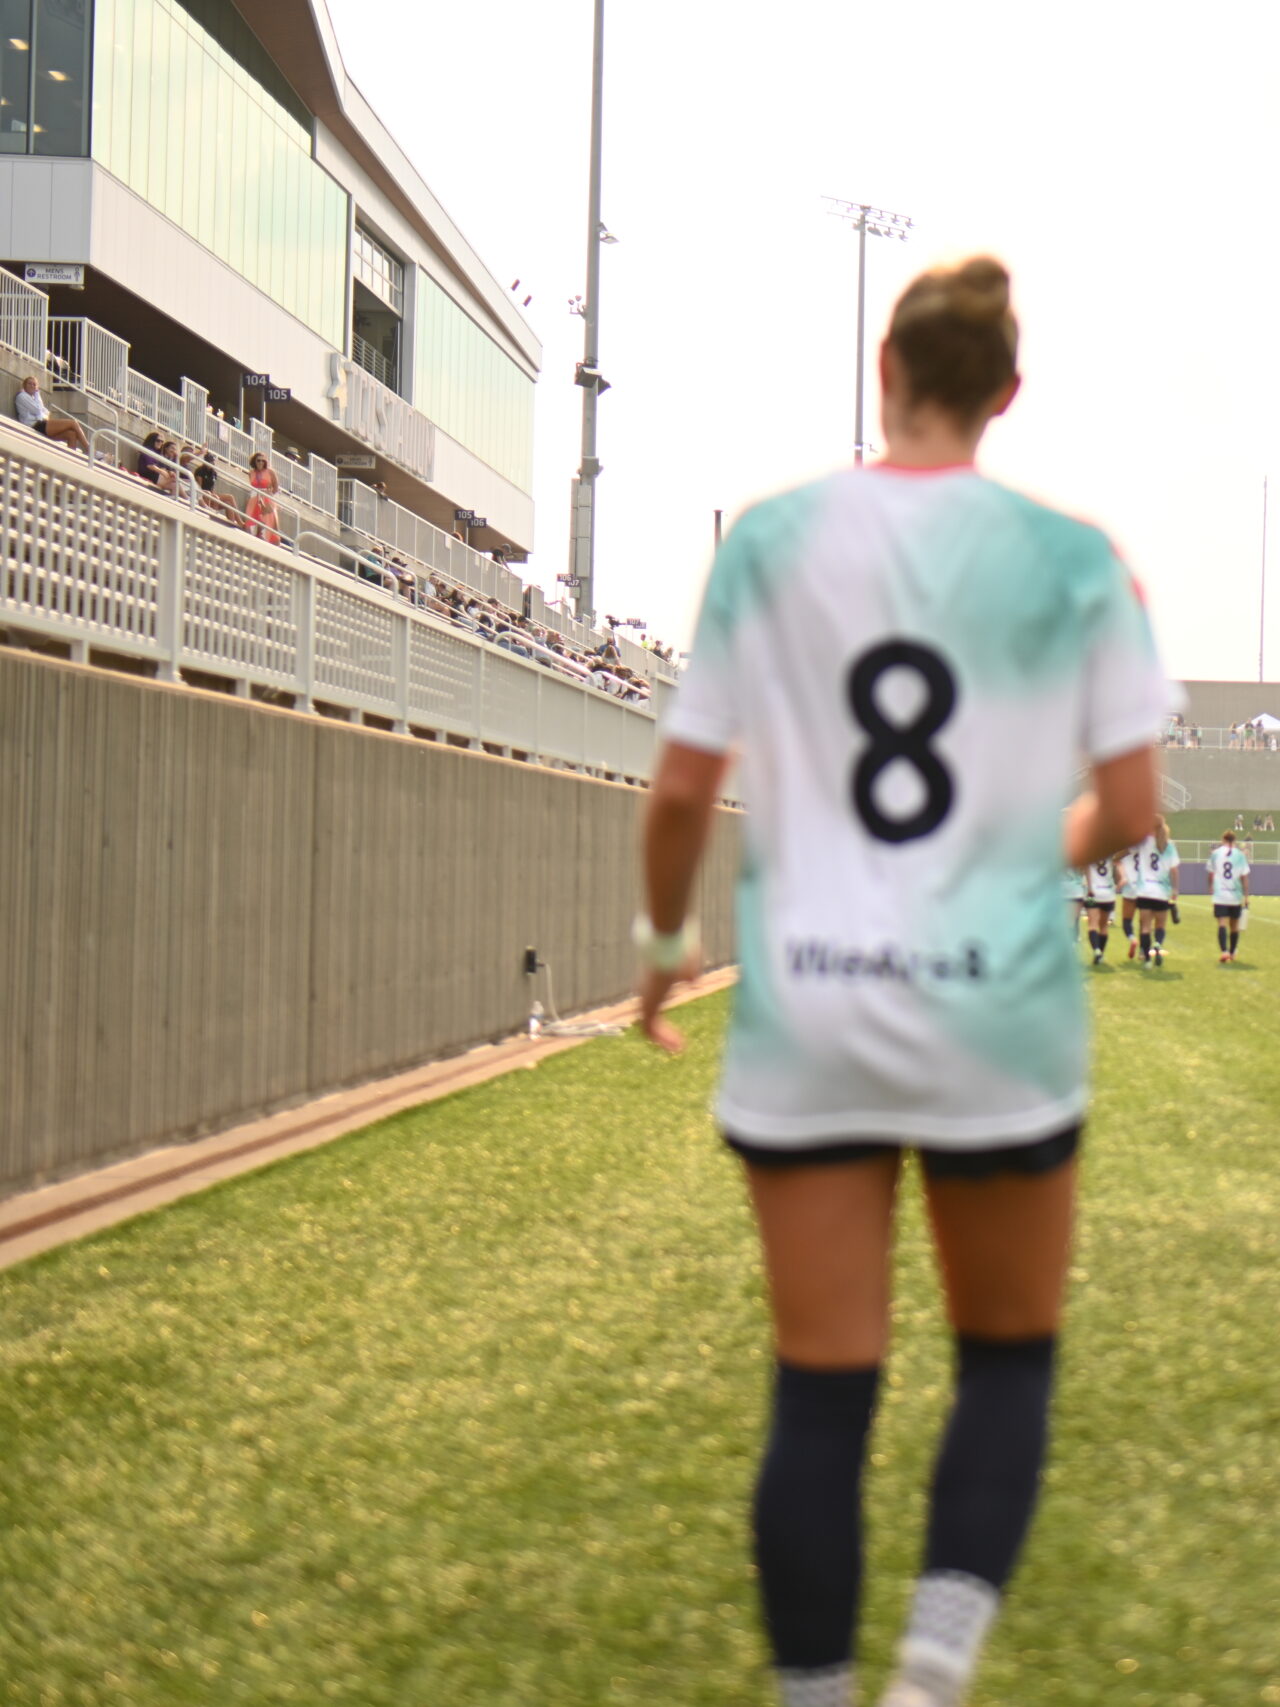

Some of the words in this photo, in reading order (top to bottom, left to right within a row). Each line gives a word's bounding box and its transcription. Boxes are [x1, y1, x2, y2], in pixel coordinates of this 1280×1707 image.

[246, 375, 266, 386] 104
[268, 389, 288, 400] 105
[457, 510, 473, 519] 105
[471, 519, 485, 527] 106
[847, 637, 957, 845] 8
[1150, 853, 1159, 871] 8
[1223, 862, 1232, 879] 8
